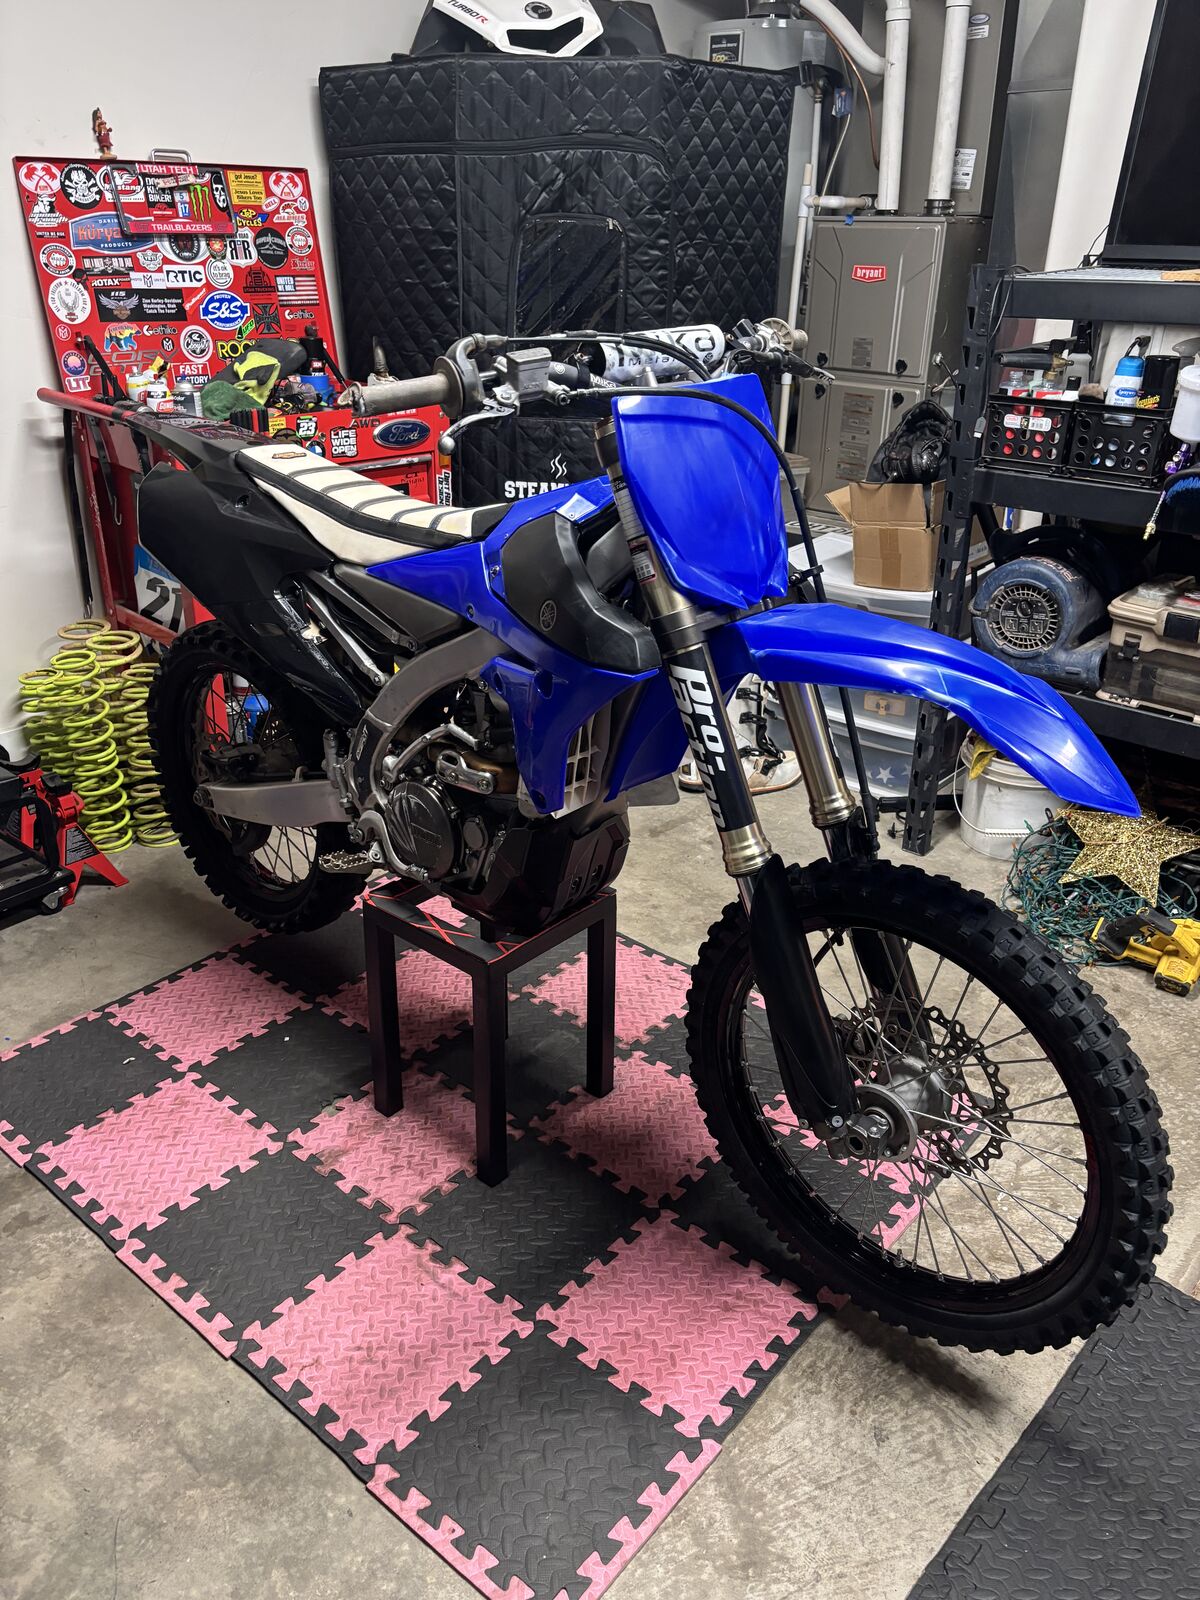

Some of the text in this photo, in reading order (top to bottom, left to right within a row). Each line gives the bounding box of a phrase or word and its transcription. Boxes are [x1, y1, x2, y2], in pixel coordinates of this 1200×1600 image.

[141, 164, 193, 174] UTAH TECH
[149, 194, 172, 202] BIKER!
[236, 217, 262, 226] CYCLES
[151, 223, 212, 231] TRAILBLAZERS
[165, 270, 203, 283] RTIC
[856, 267, 882, 279] bryant
[92, 278, 119, 286] ROTAX
[180, 364, 203, 375] FAST
[177, 375, 208, 384] FCTORY
[350, 418, 380, 429] AWD
[299, 422, 316, 435] 23
[389, 424, 420, 442] Ford
[331, 429, 356, 438] LIFE
[332, 437, 356, 446] WIDE
[332, 445, 357, 454] OPEN
